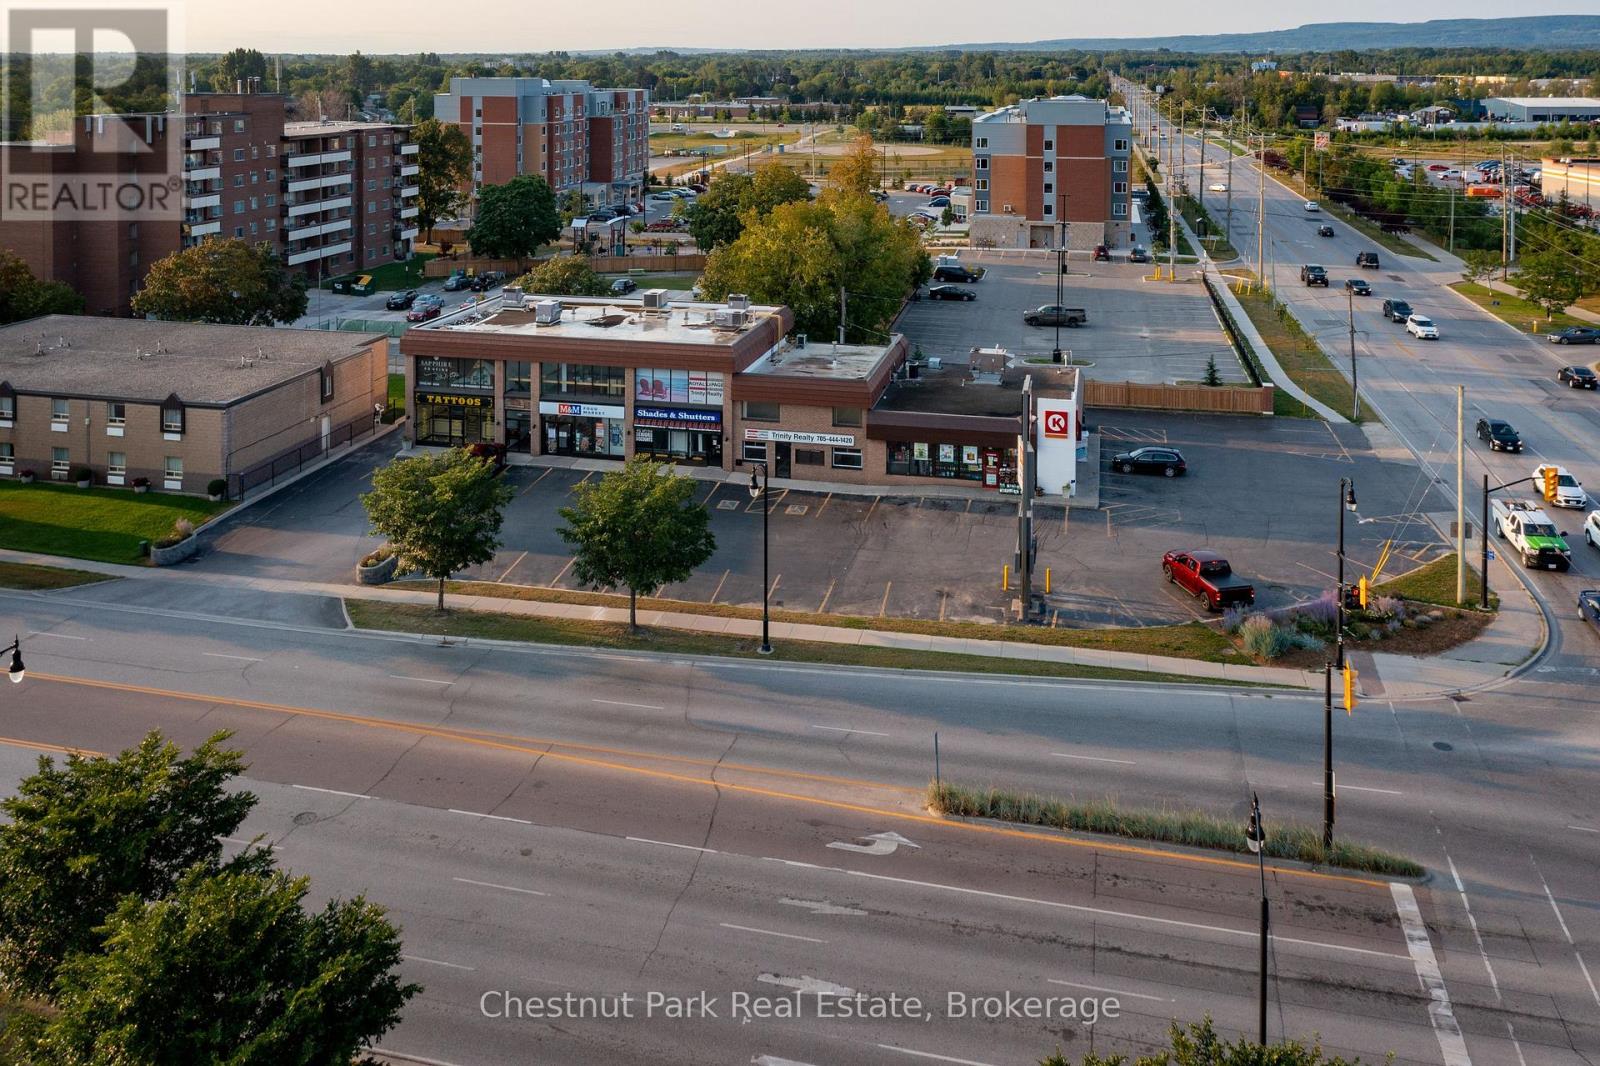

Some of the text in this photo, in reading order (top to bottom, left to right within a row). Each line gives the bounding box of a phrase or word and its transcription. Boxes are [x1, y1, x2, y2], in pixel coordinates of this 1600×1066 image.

[427, 395, 481, 406] TATTOOS
[559, 405, 580, 414] M&M
[637, 409, 716, 421] Shades & Shutters
[772, 432, 792, 440] Trinity
[793, 433, 815, 442] Realty
[816, 435, 853, 443] 705-444-1420
